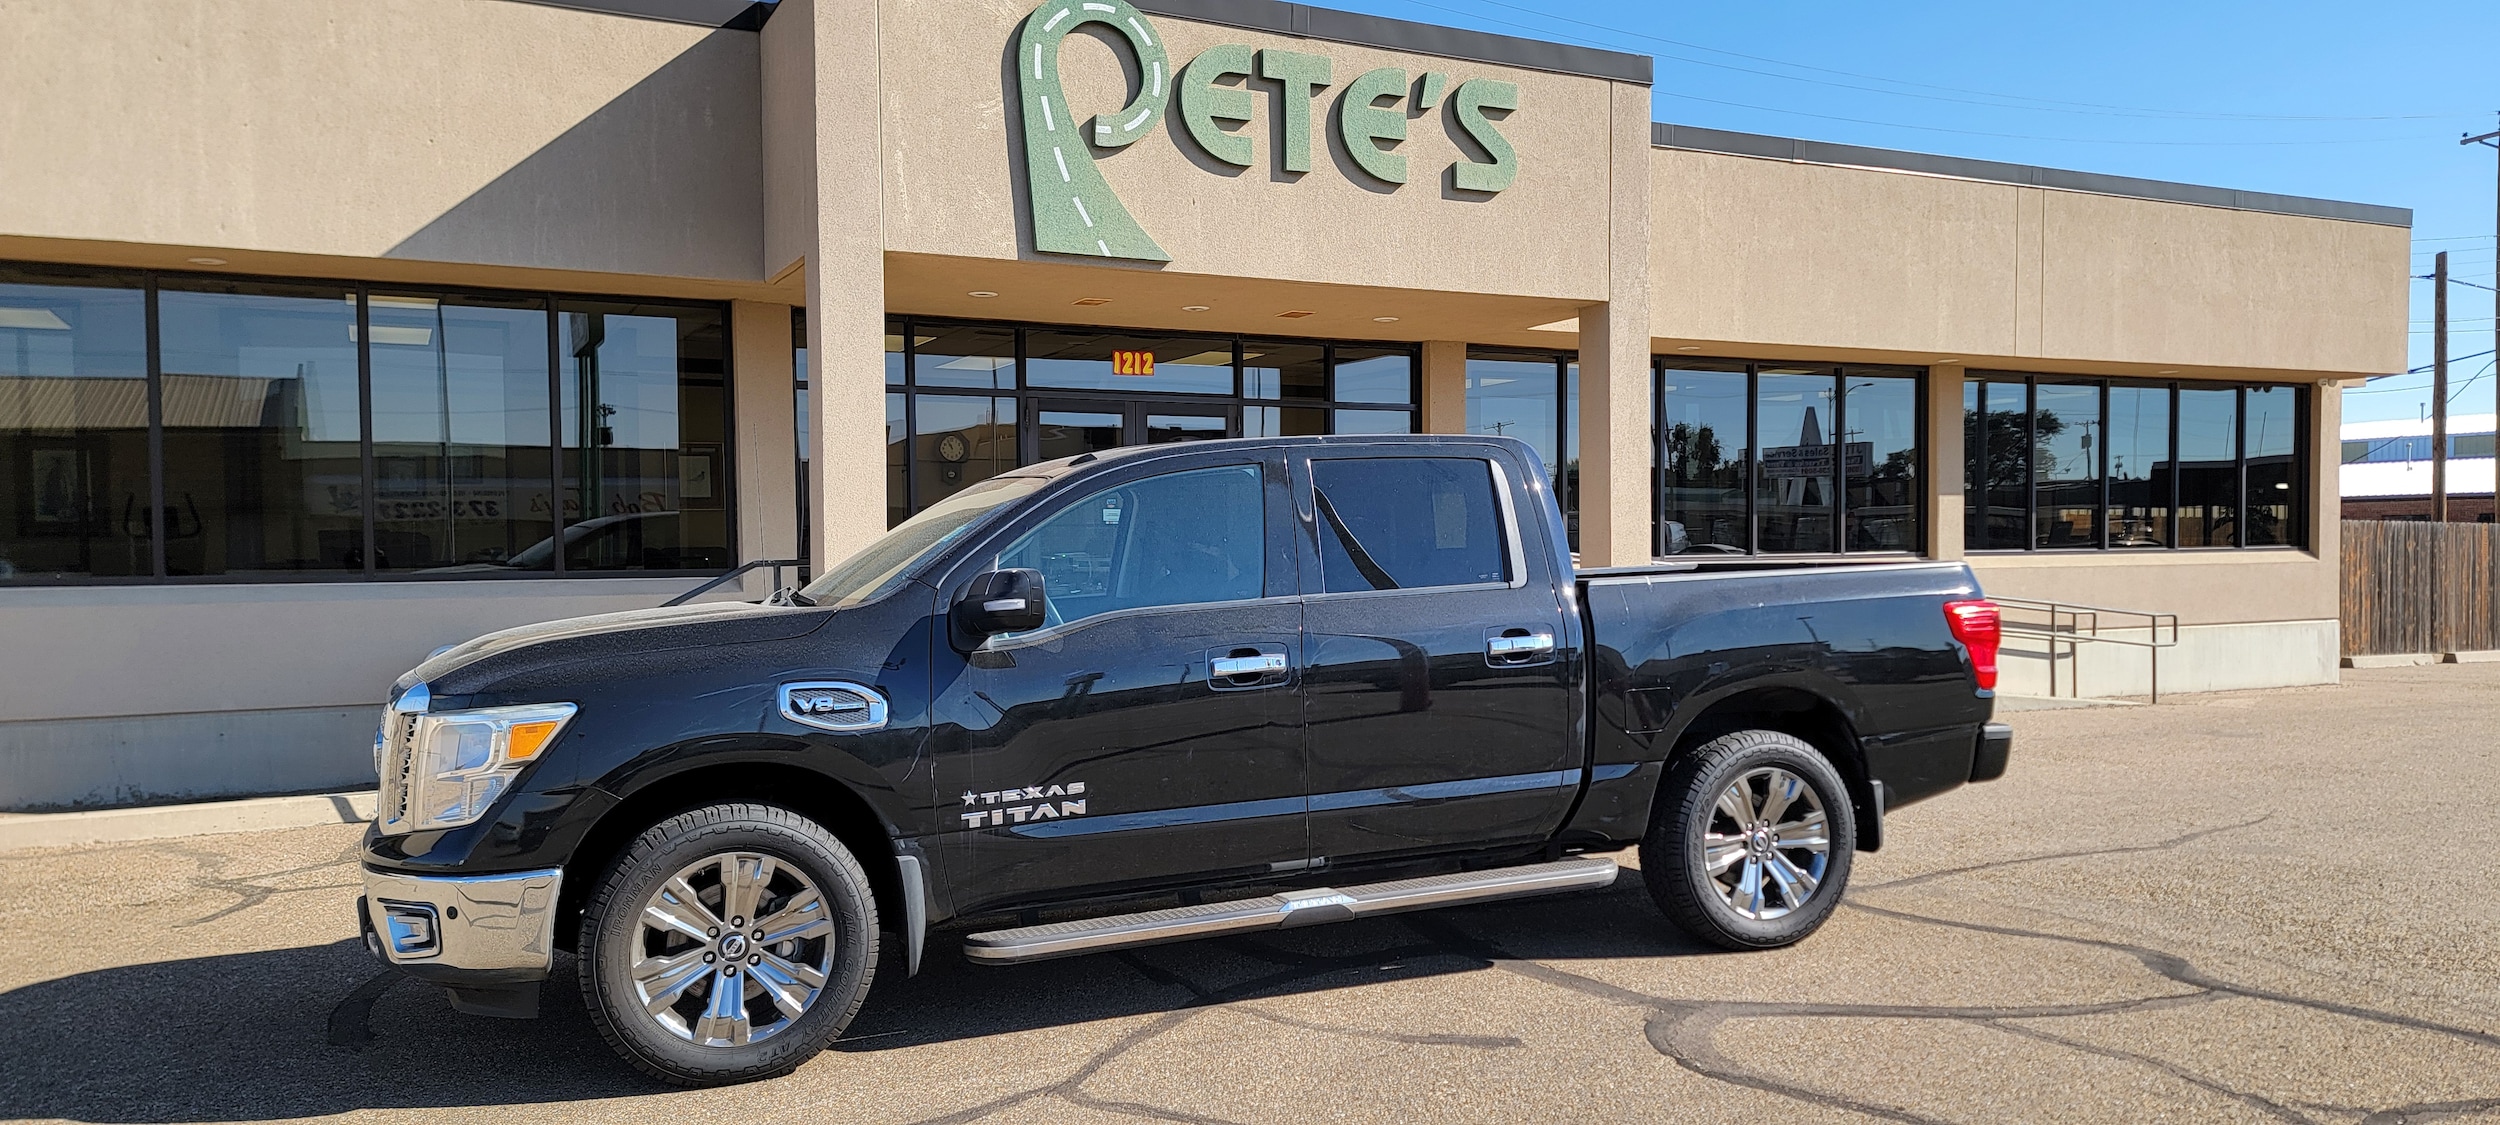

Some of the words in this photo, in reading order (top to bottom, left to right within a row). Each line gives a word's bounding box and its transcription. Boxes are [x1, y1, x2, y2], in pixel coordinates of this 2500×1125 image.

[1018, 0, 1519, 262] PETE'S
[1113, 351, 1154, 375] 1212
[793, 696, 834, 713] V8
[980, 780, 1086, 805] TEXAS
[961, 798, 1087, 829] TITAN
[610, 862, 663, 938] IRONMAN
[842, 909, 857, 951] ALL
[800, 957, 856, 1043] COUNTRY
